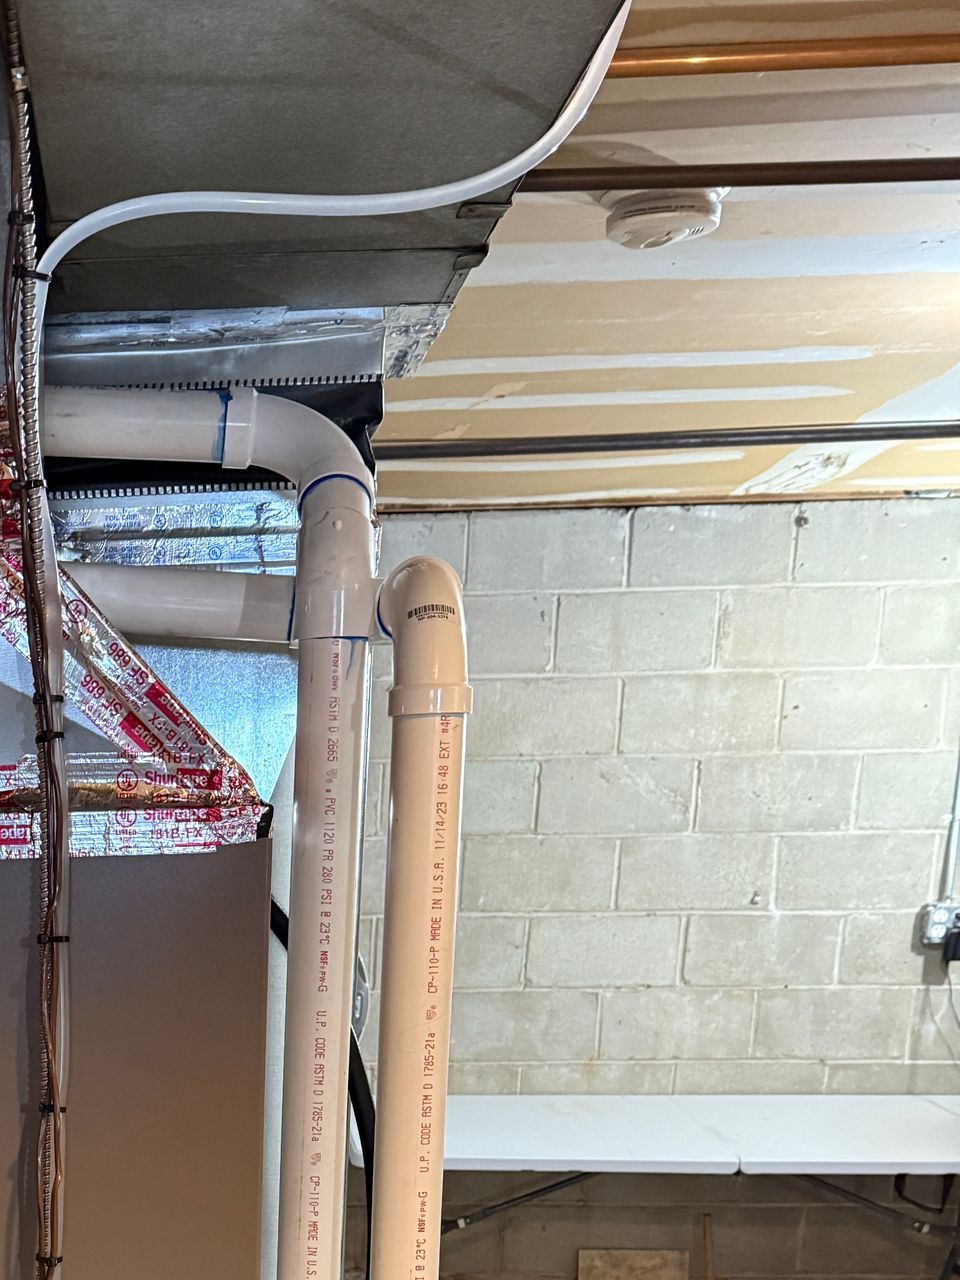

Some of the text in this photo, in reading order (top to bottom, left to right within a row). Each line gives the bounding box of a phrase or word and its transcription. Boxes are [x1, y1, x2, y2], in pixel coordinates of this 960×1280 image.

[105, 642, 149, 685] SF 686
[79, 673, 123, 716] SF 686
[327, 696, 341, 721] ASTM
[326, 738, 338, 762] 2665
[439, 740, 450, 759] EXT
[144, 770, 209, 787] Shurtape
[437, 765, 449, 795] 16:48
[324, 797, 336, 816] PVC
[150, 828, 203, 840] 181B-FX
[323, 822, 336, 844] 1120
[434, 801, 447, 850] 11/14/23
[322, 848, 334, 862] PR
[321, 866, 333, 884] 280
[433, 857, 445, 893] U.S.A.
[320, 888, 332, 905] PSI
[431, 898, 443, 910] IN
[319, 922, 331, 945] 23°C
[430, 916, 442, 941] MADE
[427, 946, 440, 994] CP-110-P
[315, 1010, 327, 1032] U.P.
[315, 1036, 327, 1059] CODE
[423, 1032, 436, 1077] 1785-21a
[313, 1063, 325, 1086] ASTM
[420, 1094, 433, 1117] ASTM
[310, 1101, 324, 1142] 1785-21a
[420, 1122, 432, 1146] CODE
[419, 1151, 430, 1173] U.P.
[308, 1176, 321, 1216] CP-110-P
[307, 1221, 318, 1241] MADE
[307, 1246, 318, 1256] IN
[415, 1238, 426, 1261] 23°C
